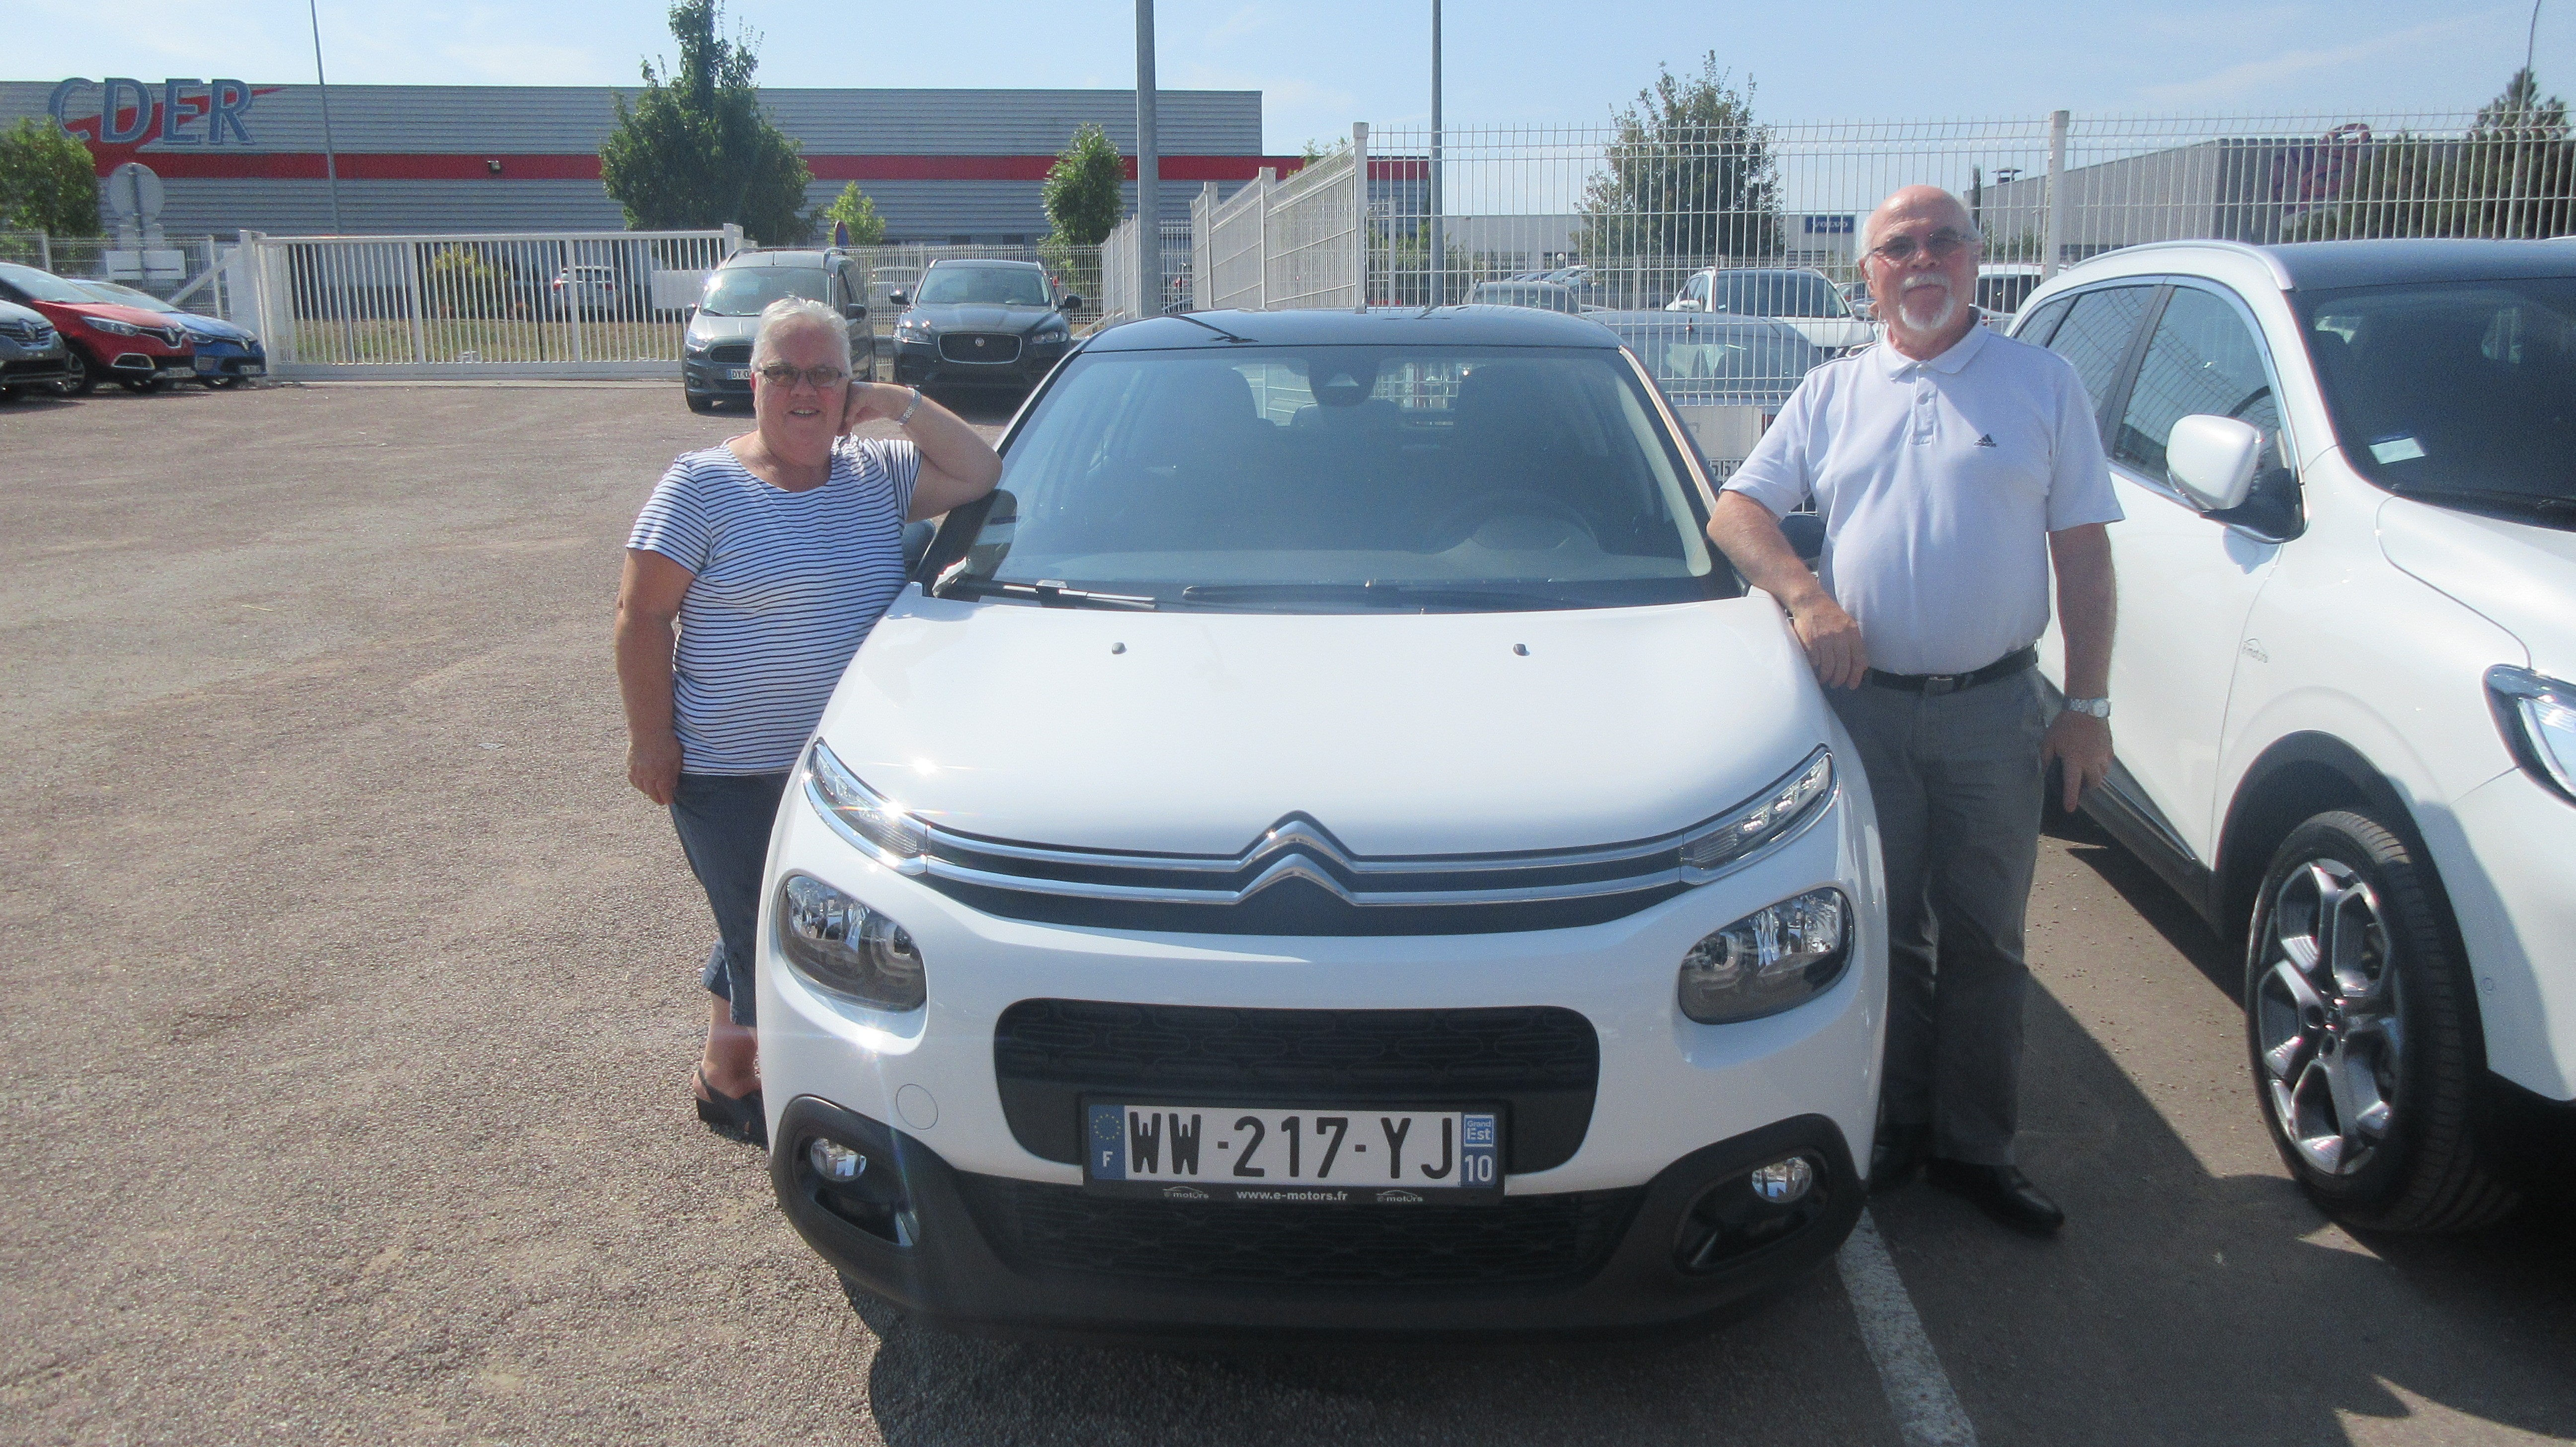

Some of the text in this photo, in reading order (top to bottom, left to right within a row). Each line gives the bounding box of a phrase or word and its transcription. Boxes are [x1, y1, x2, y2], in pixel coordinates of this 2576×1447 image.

[48, 77, 256, 145] CDER
[1467, 1127, 1491, 1140] Est
[1129, 1111, 1452, 1180] WW-217-YJ
[1103, 1150, 1113, 1167] F
[1464, 1154, 1492, 1182] 10
[1236, 1191, 1348, 1201] www.e-motors.fr
